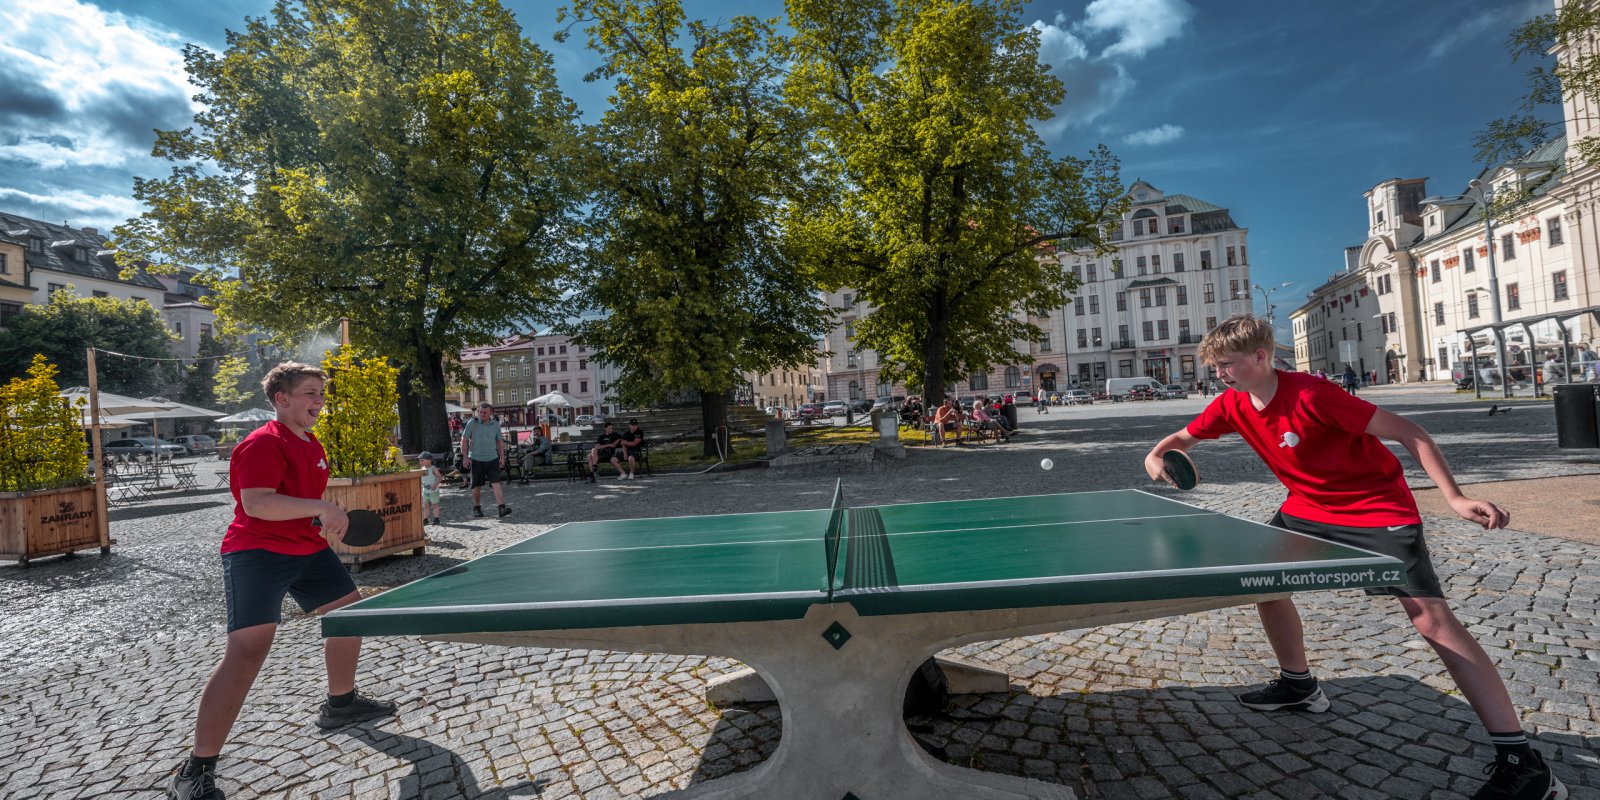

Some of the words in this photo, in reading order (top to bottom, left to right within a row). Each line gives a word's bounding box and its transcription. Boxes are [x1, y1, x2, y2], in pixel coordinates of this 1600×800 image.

[41, 510, 93, 524] ZAHRADY
[372, 503, 412, 517] AHRADY
[1240, 569, 1400, 587] www.kantorsport.cz
